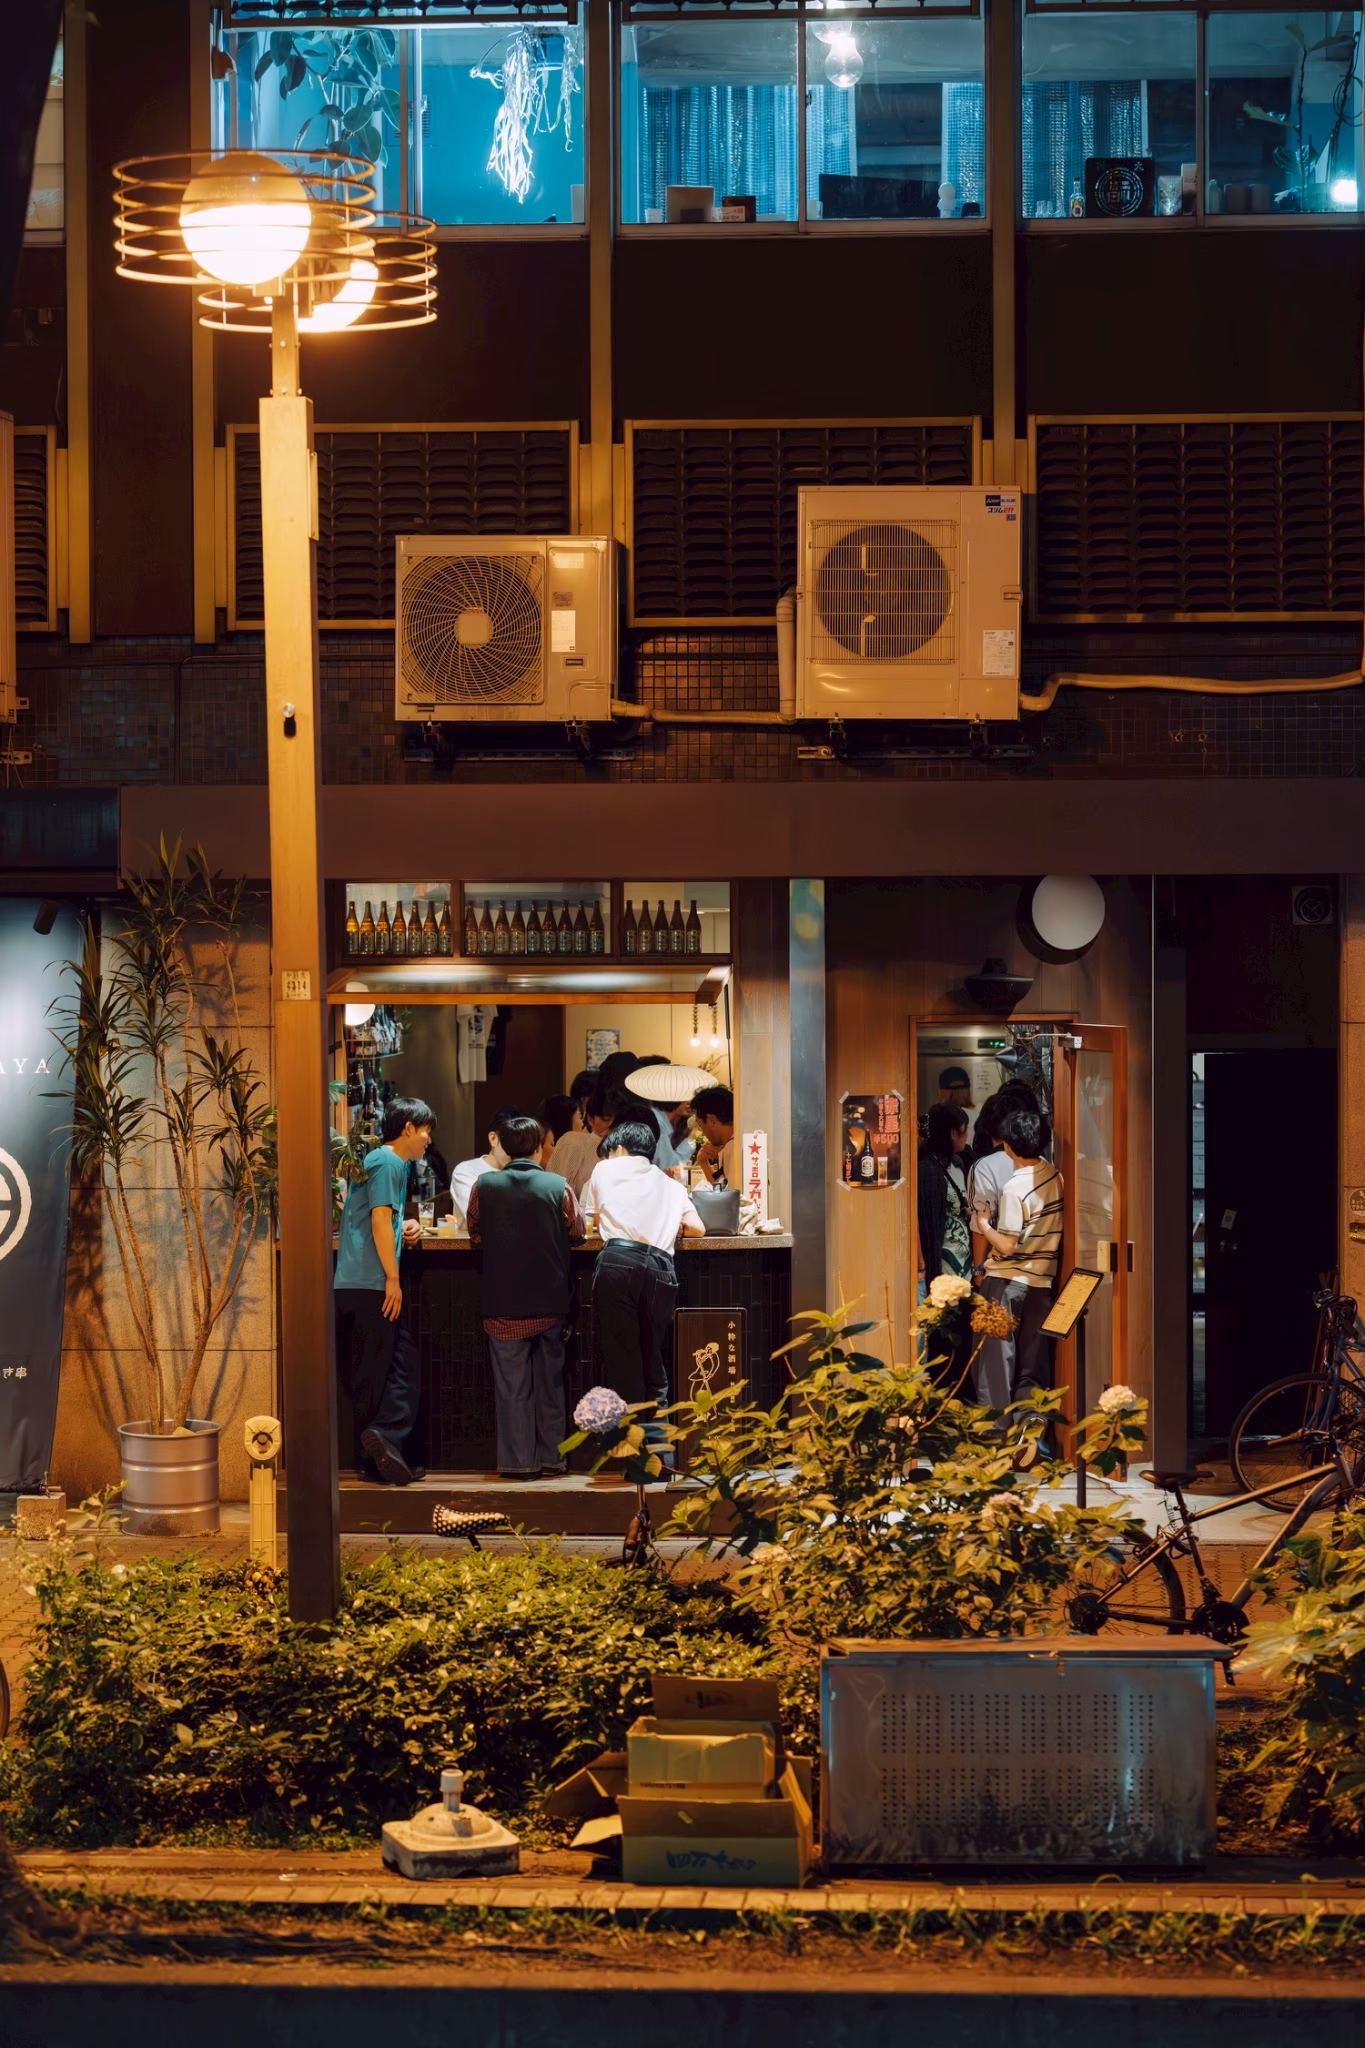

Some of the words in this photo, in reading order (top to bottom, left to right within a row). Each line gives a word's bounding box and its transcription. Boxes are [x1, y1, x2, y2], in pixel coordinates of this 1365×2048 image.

[727, 1320, 737, 1375] 小粋な酒場
